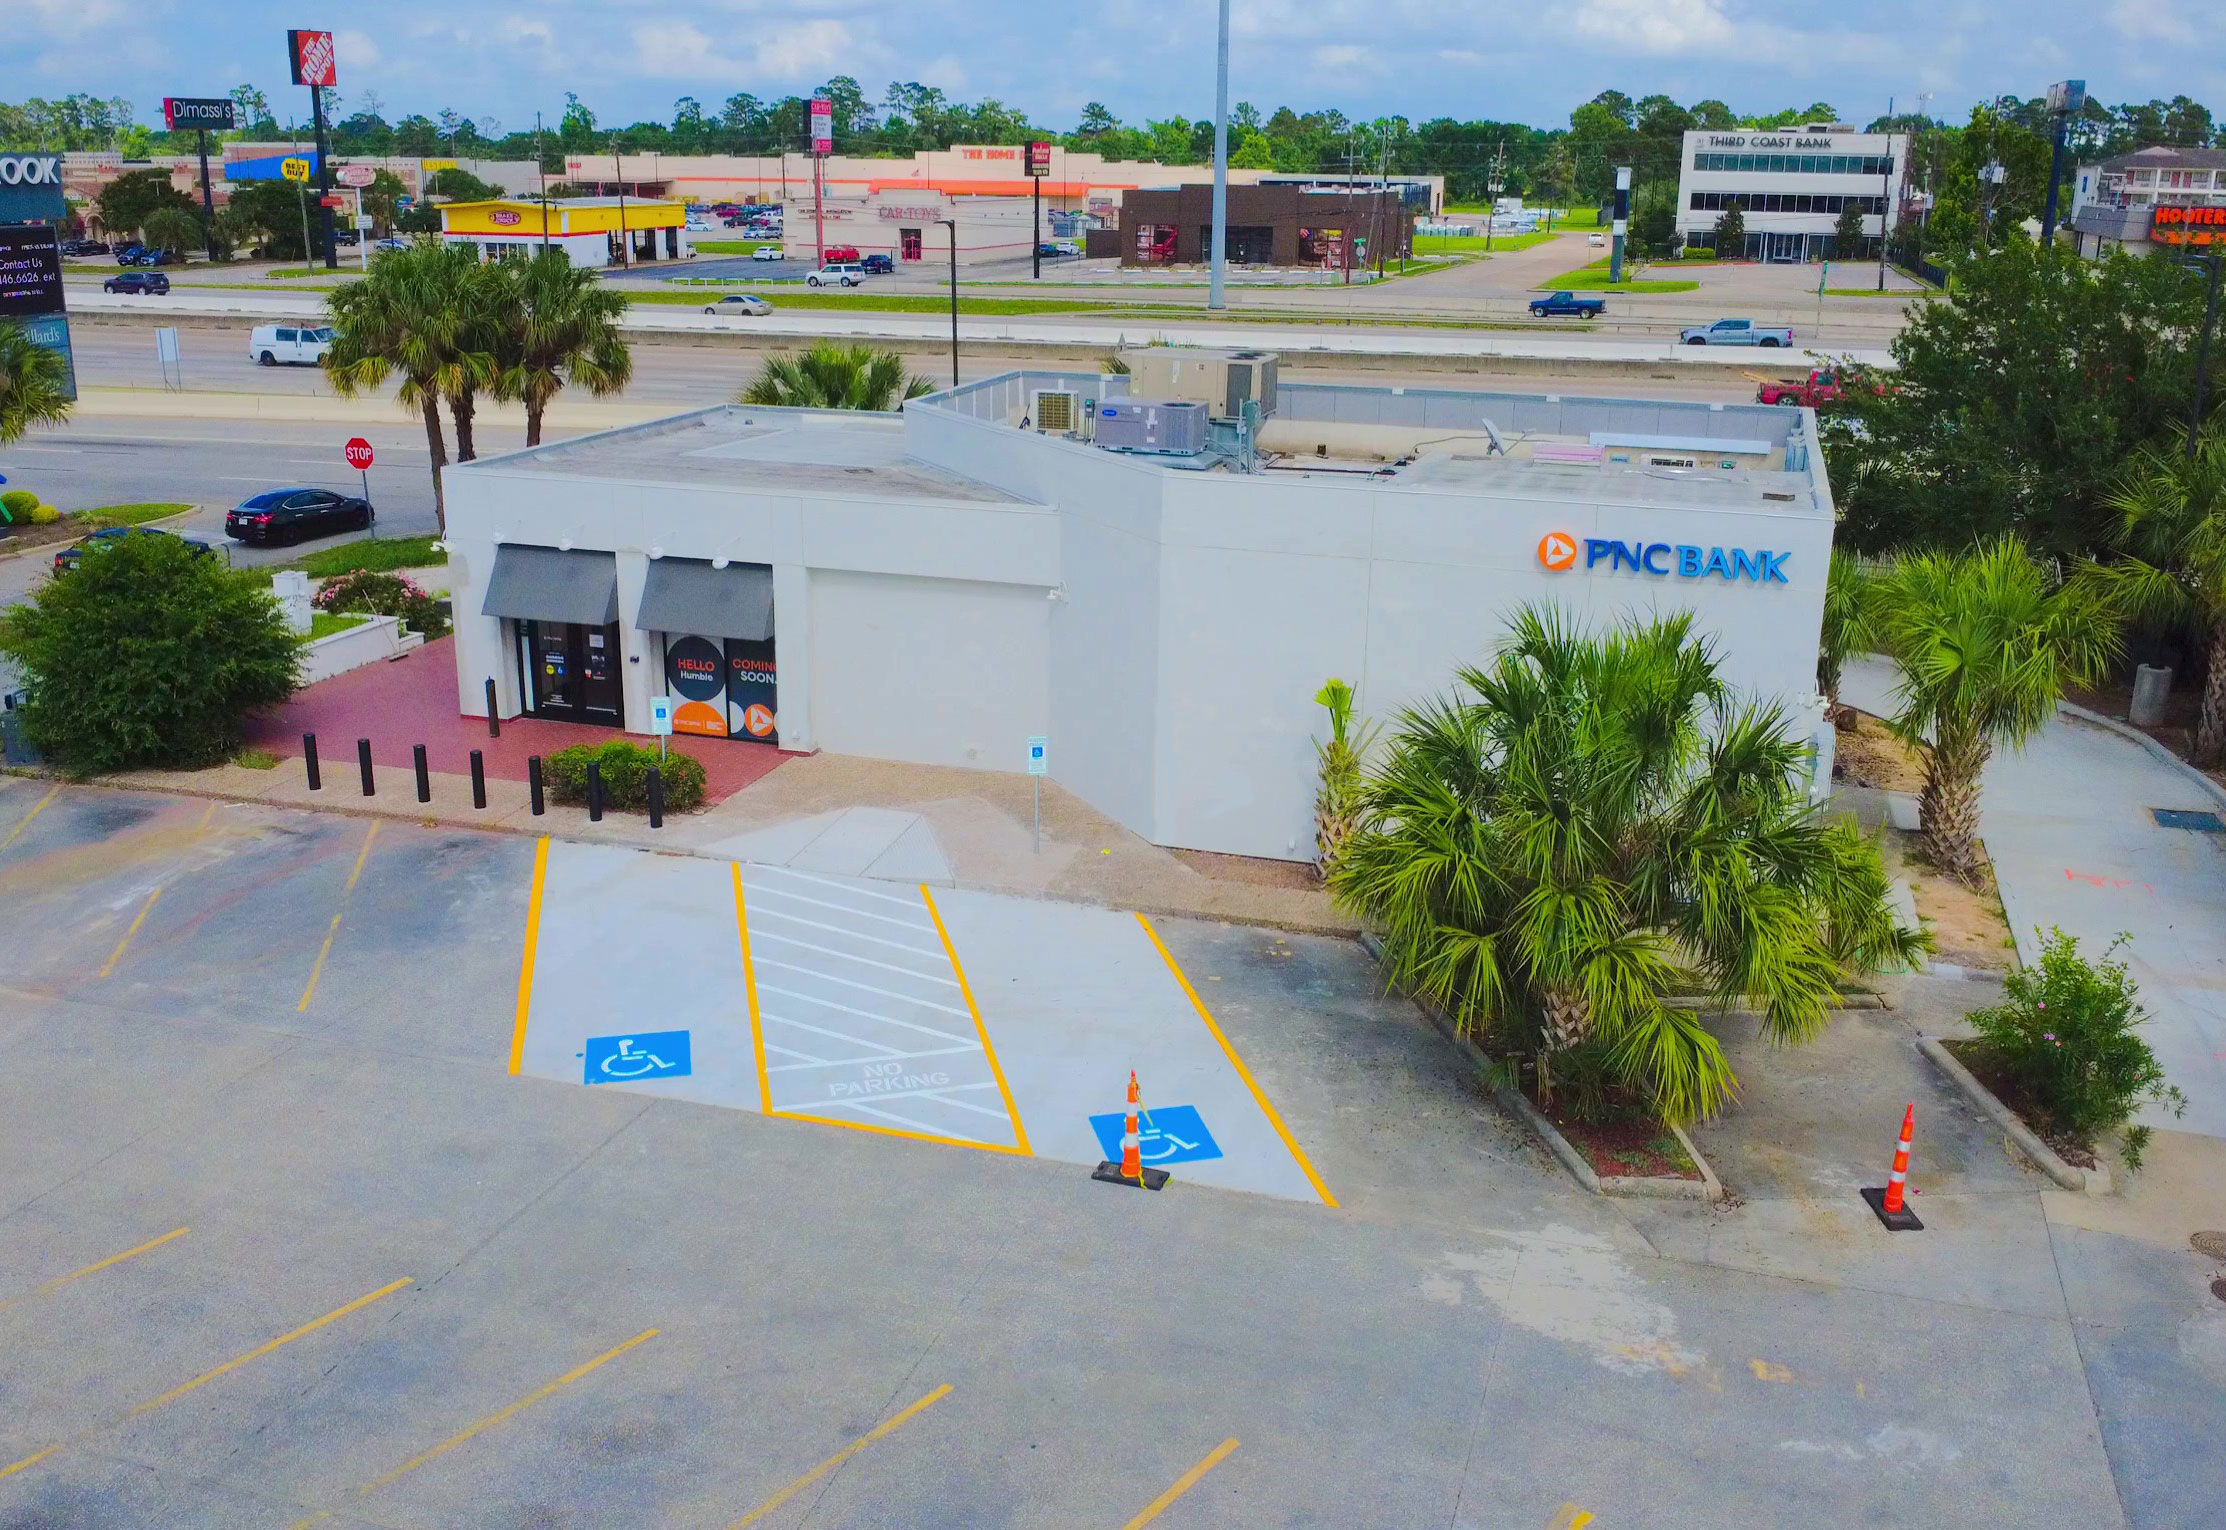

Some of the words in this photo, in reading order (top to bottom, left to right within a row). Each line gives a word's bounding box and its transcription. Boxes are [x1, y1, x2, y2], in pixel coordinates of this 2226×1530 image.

[301, 32, 332, 85] HOME
[315, 51, 334, 84] DEPOT
[172, 101, 231, 118] Dimassi's
[1709, 135, 1745, 147] THIRD
[1751, 136, 1791, 148] COAST
[1796, 137, 1832, 149] BANK
[0, 157, 59, 185] OOK
[2155, 207, 2226, 225] HOOTER
[32, 257, 43, 268] Us
[346, 446, 372, 460] STOP
[1584, 538, 1671, 575] PNC
[1676, 545, 1791, 584] BANK
[678, 659, 714, 672] HELLO
[680, 670, 714, 682] Humble
[863, 1062, 902, 1078] NO
[828, 1072, 950, 1098] PARKING
